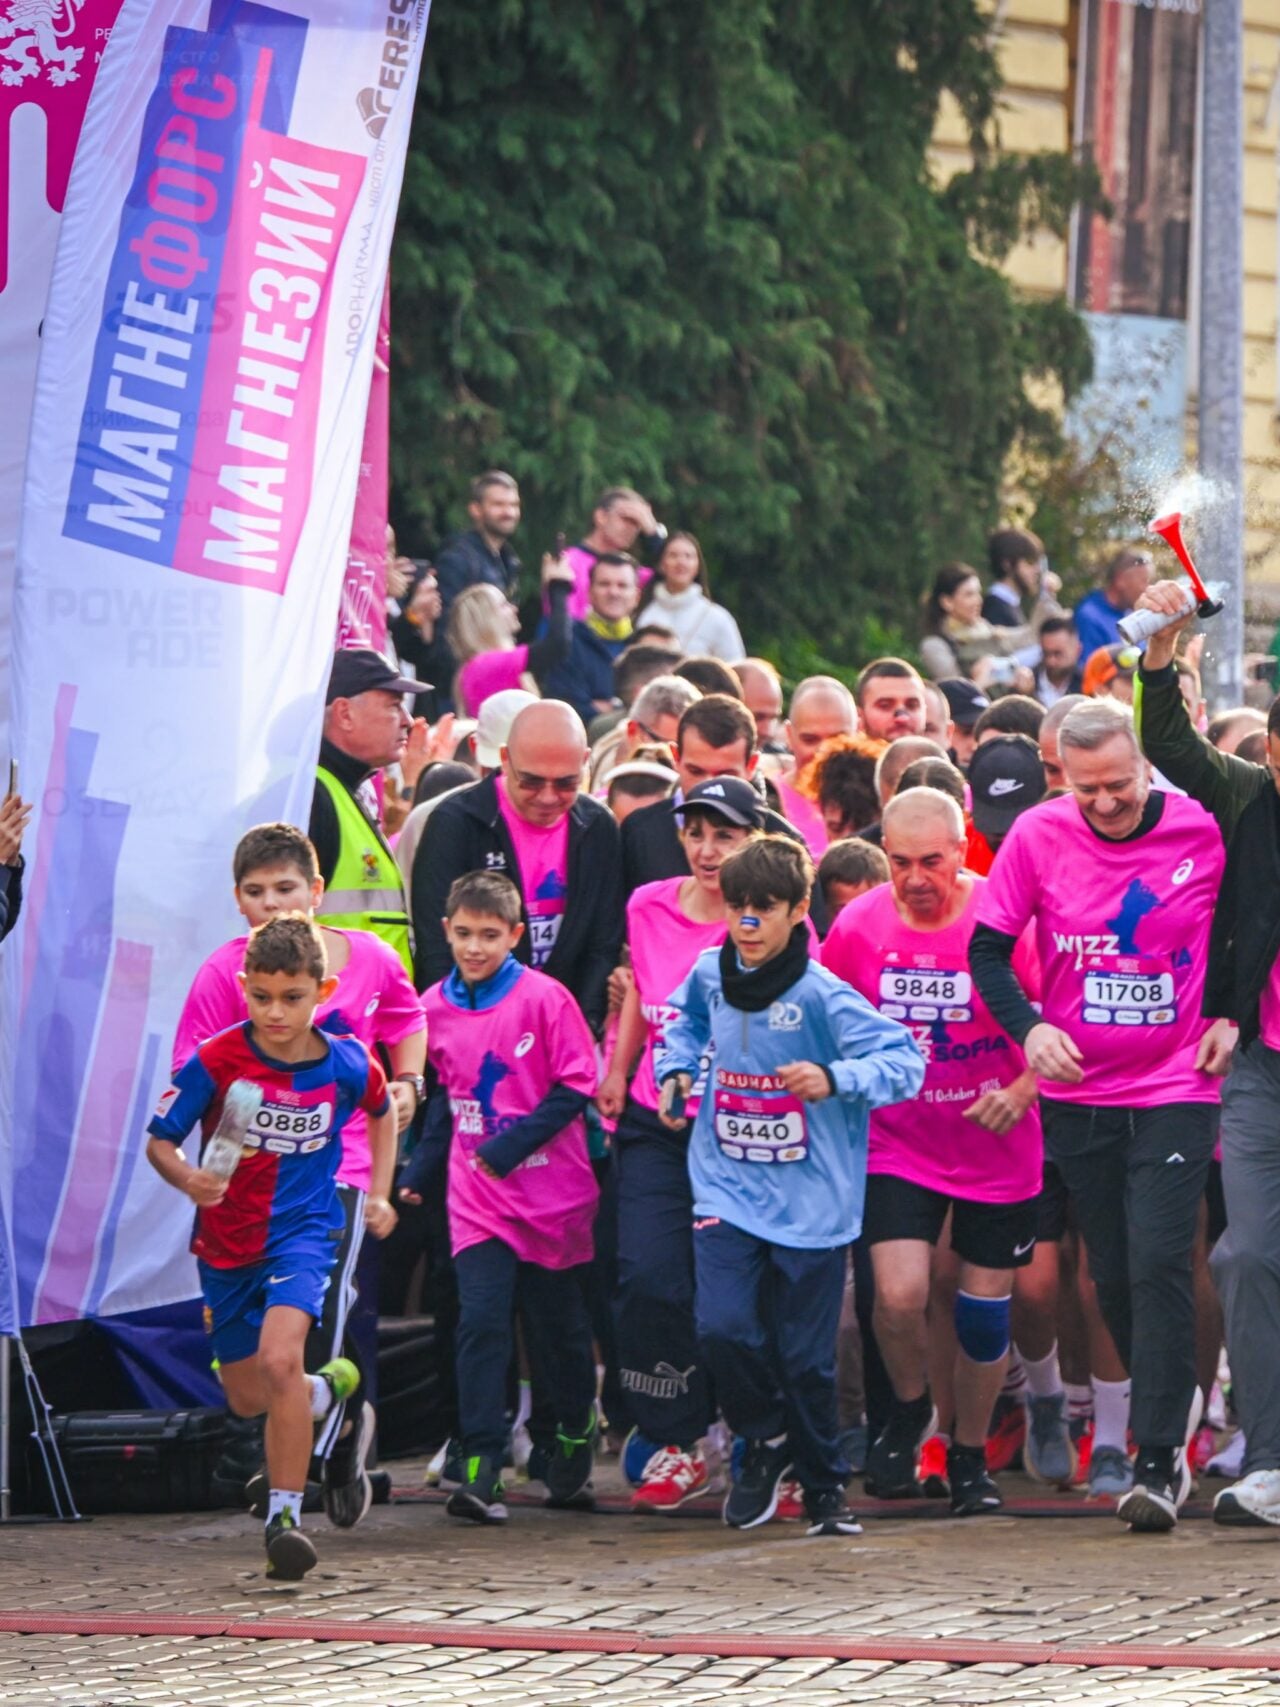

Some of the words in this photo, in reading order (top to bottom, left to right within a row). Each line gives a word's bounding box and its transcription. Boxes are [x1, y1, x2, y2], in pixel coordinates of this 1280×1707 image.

[203, 154, 341, 573] МАГНЕЗИЙ
[45, 588, 224, 626] POWER
[126, 630, 222, 668] ADE
[1052, 931, 1120, 971] WIZZ
[894, 977, 956, 999] 9848
[1096, 981, 1163, 1002] 11708
[934, 1035, 1009, 1062] SOFIA
[718, 1070, 787, 1091] BAUHAU
[256, 1110, 322, 1134] 0888
[727, 1119, 789, 1140] 9440
[620, 1367, 678, 1399] PUMA
